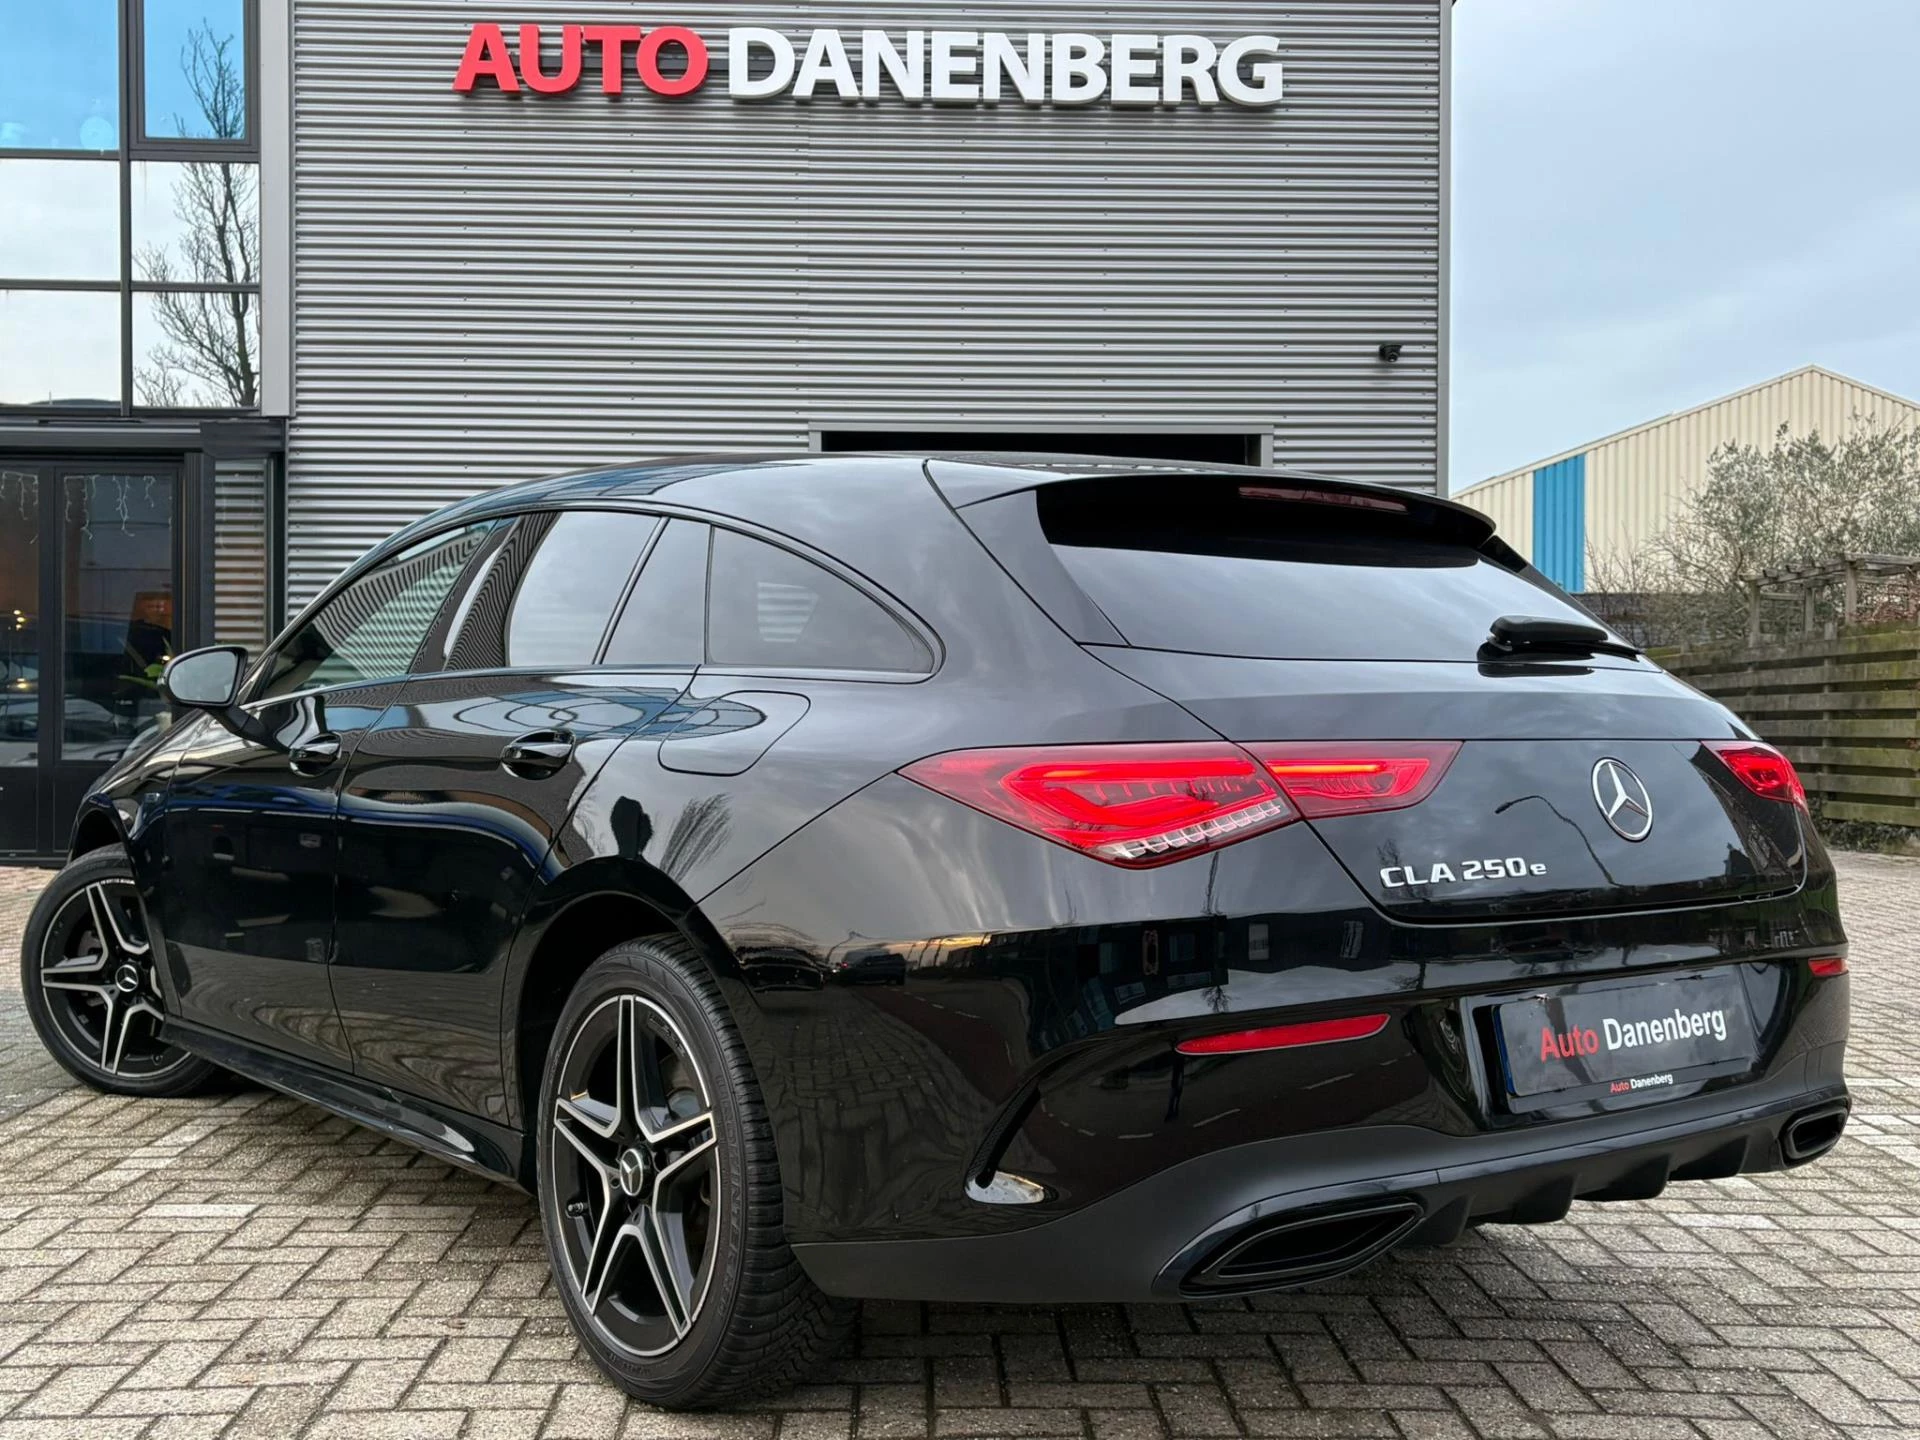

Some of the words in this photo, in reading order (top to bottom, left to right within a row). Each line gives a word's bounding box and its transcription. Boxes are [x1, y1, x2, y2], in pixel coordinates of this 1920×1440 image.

[452, 23, 711, 97] AUTO
[728, 27, 1285, 109] DANENBERG
[1379, 863, 1456, 888] CLA
[1541, 1024, 1599, 1062] Auto
[1602, 1008, 1728, 1051] Danenberg
[1610, 1081, 1630, 1093] Auto
[1630, 1073, 1674, 1089] Danenberg
